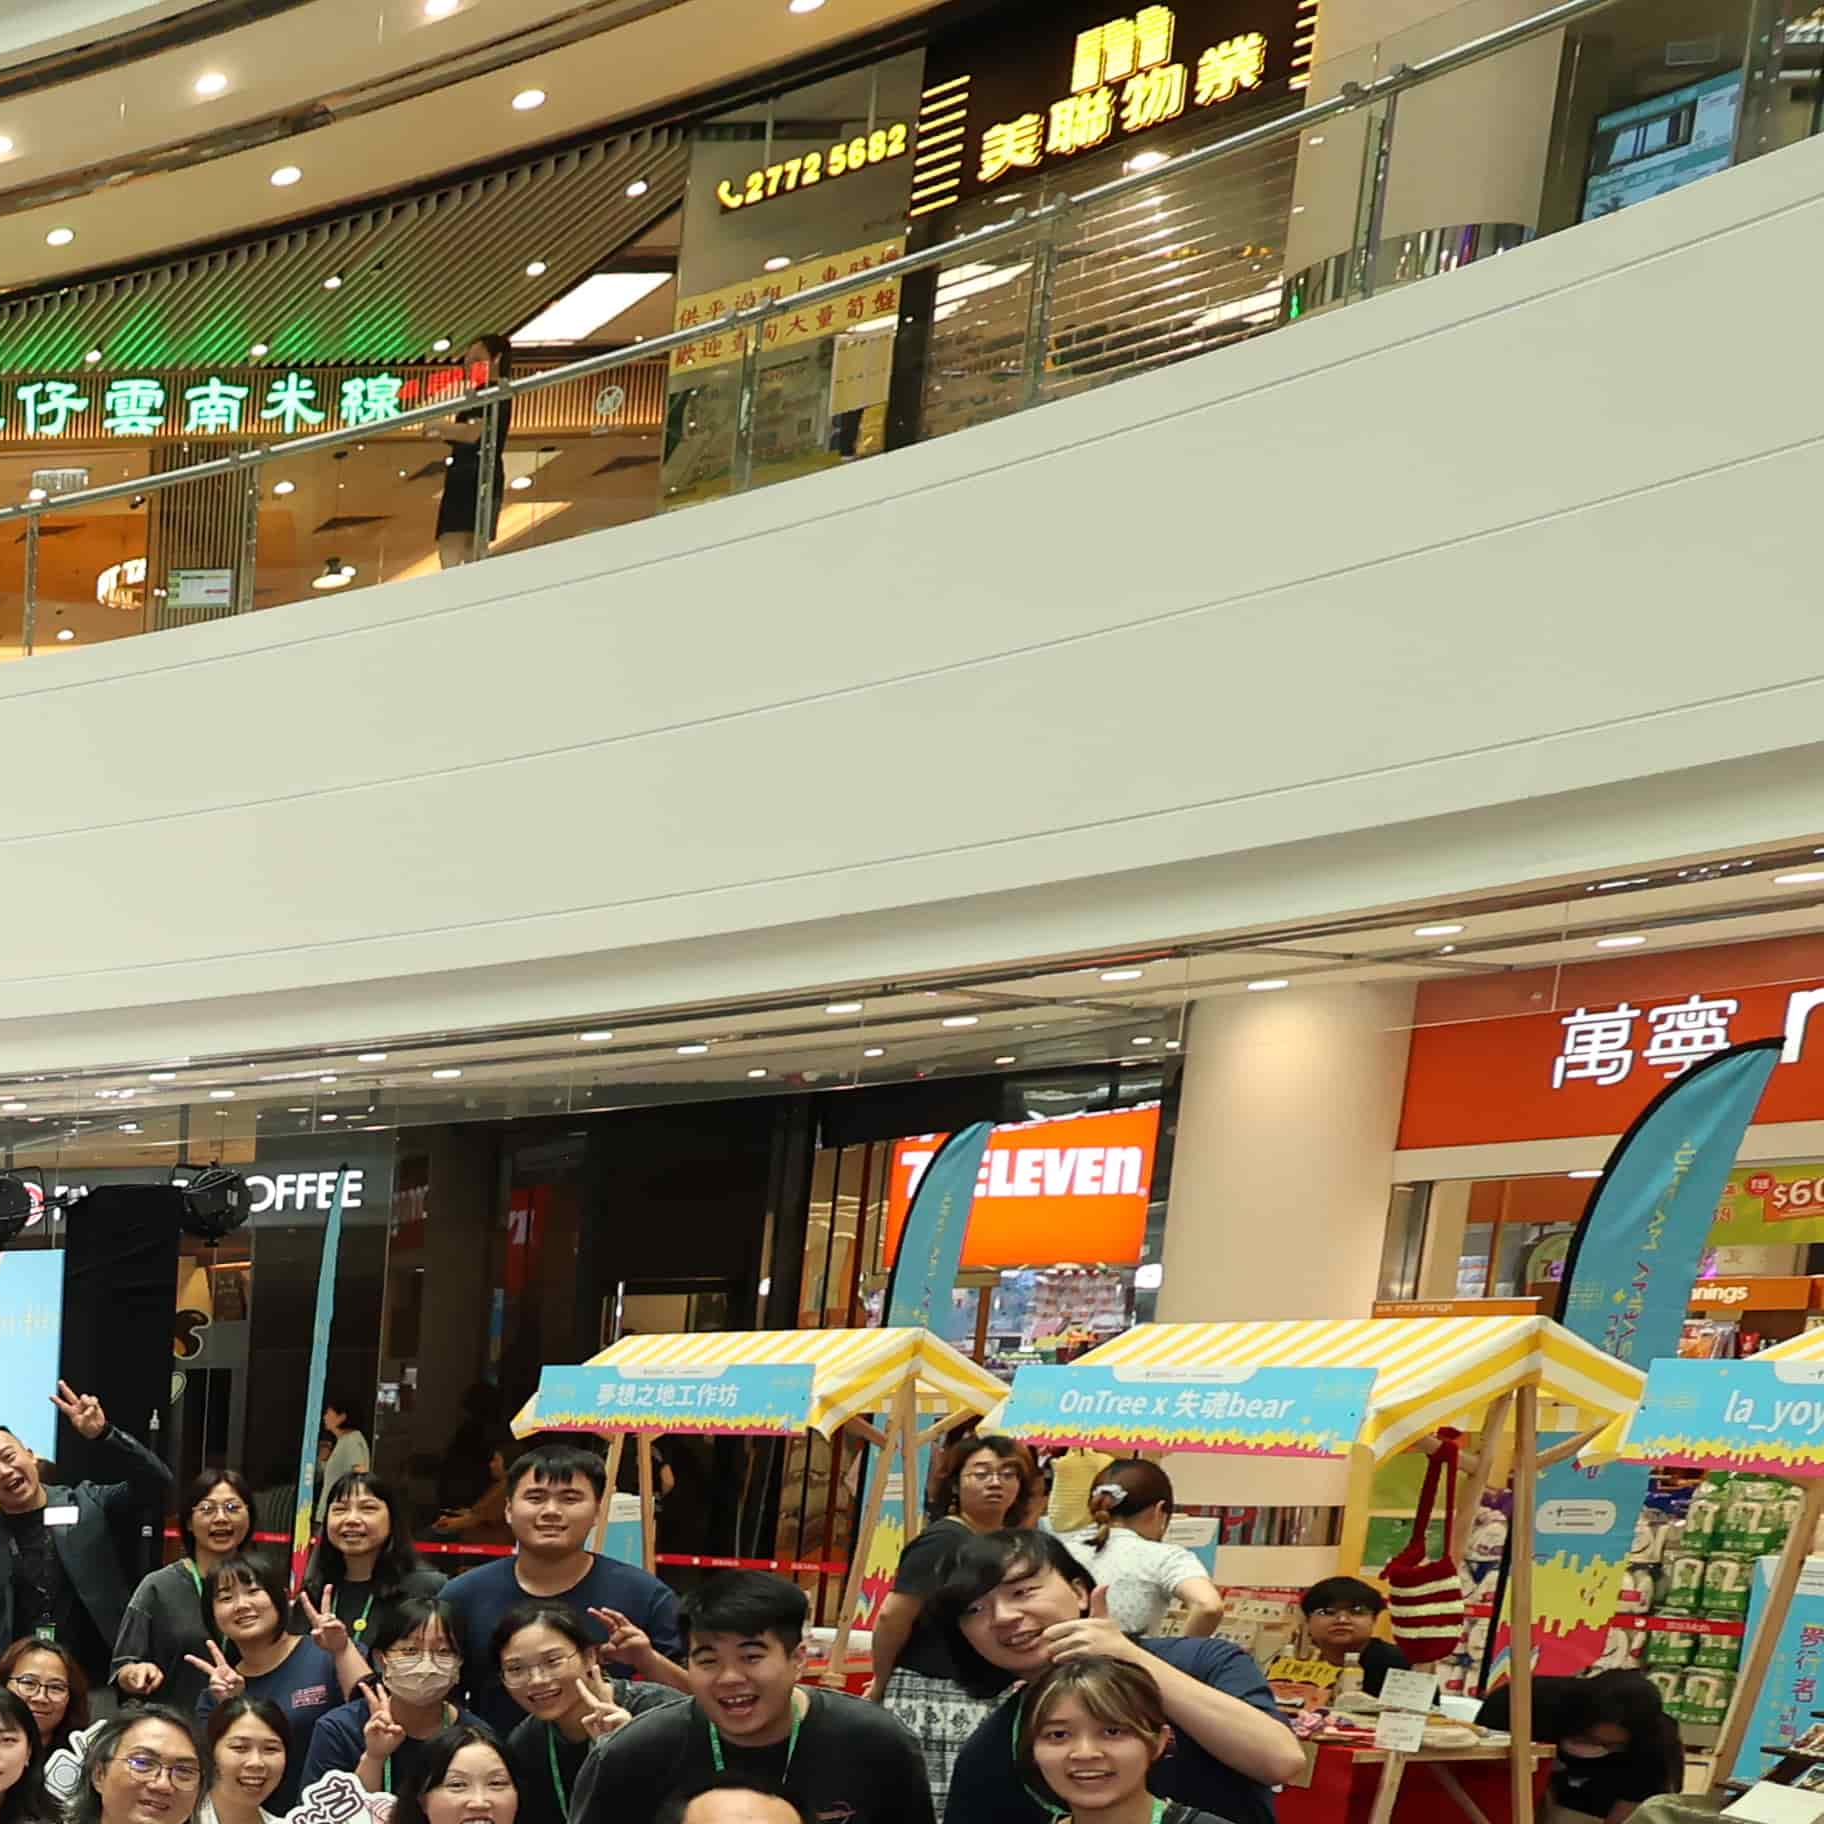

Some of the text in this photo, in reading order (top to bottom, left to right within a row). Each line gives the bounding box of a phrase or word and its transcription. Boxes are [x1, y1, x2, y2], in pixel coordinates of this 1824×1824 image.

[977, 31, 1265, 184] 美聯物業
[745, 122, 908, 206] 2772 5682
[1553, 996, 1738, 1088] 萬寧
[597, 1383, 739, 1408] 夢想之地工作坊
[1058, 1389, 1147, 1418] OnTree
[1151, 1397, 1167, 1415] x
